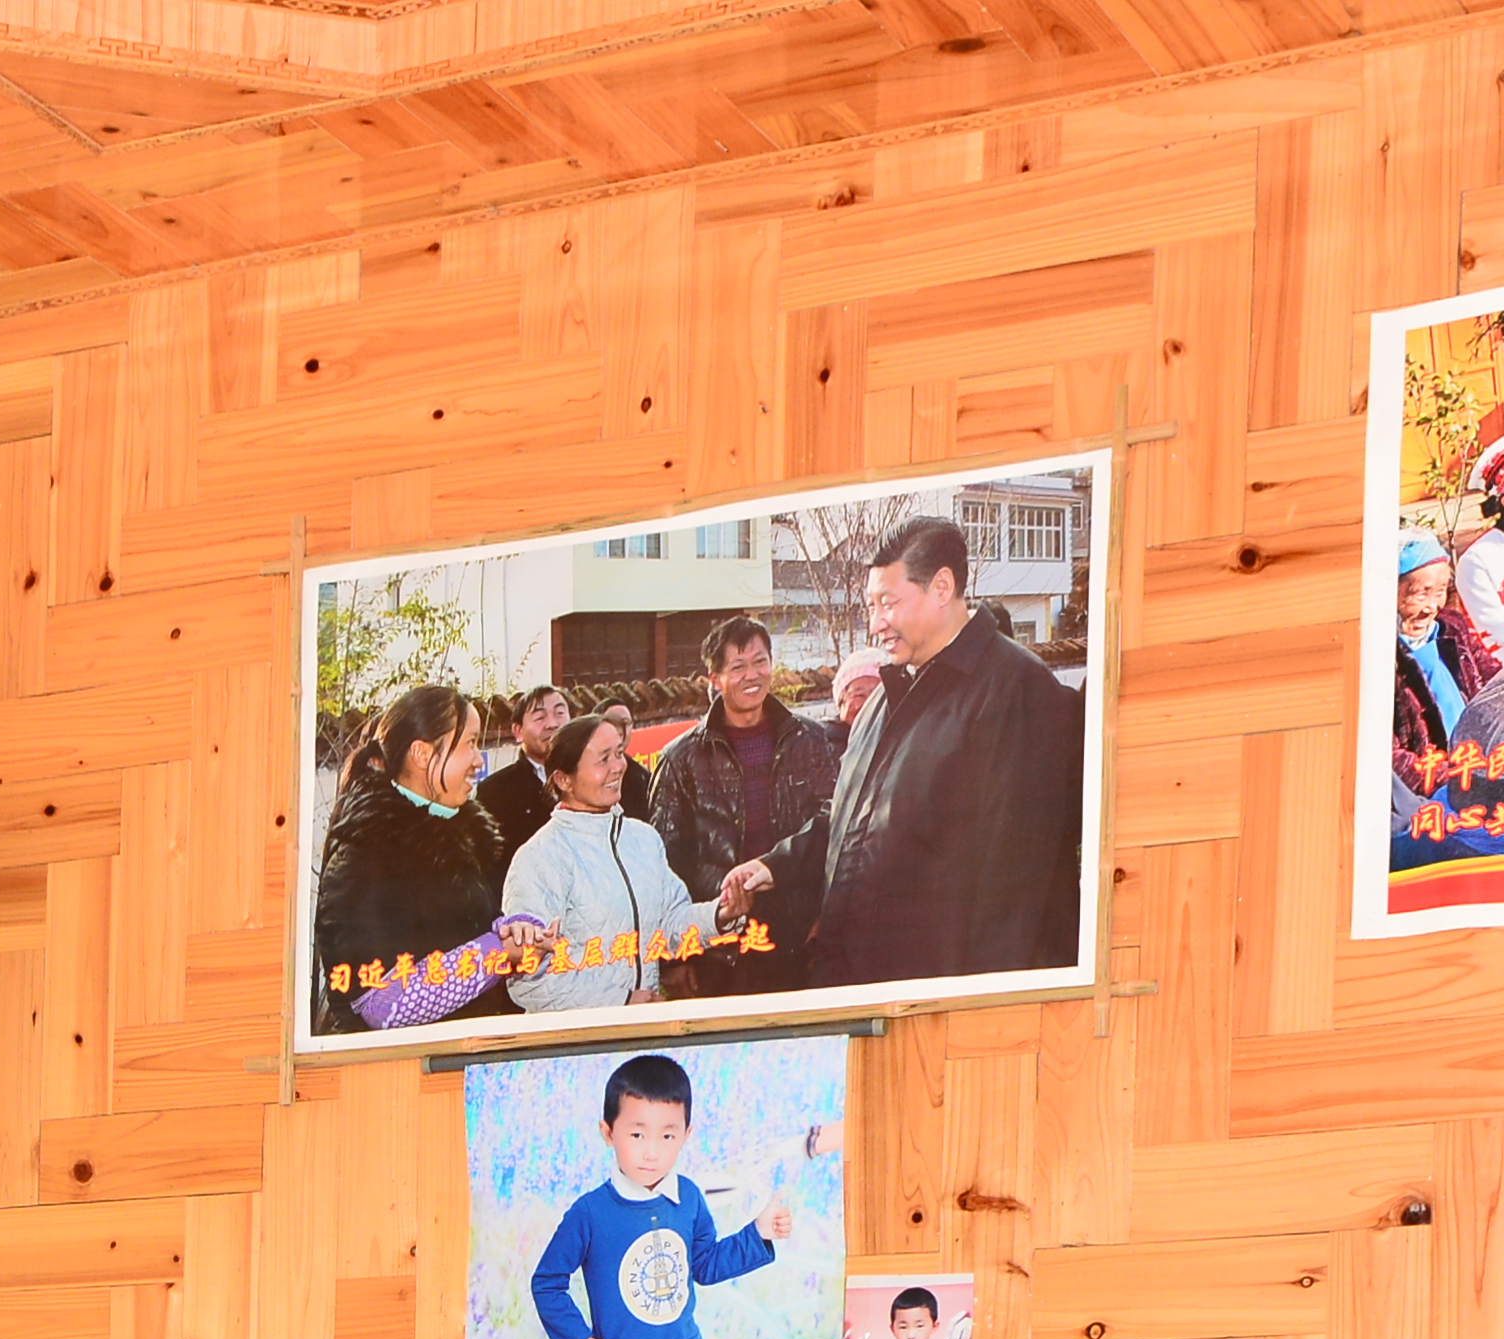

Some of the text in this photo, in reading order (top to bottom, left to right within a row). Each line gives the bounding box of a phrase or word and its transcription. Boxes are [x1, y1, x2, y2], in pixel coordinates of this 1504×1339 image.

[328, 917, 777, 994] 习近平总书记与基层群众在一起
[629, 1245, 653, 1311] KENZO
